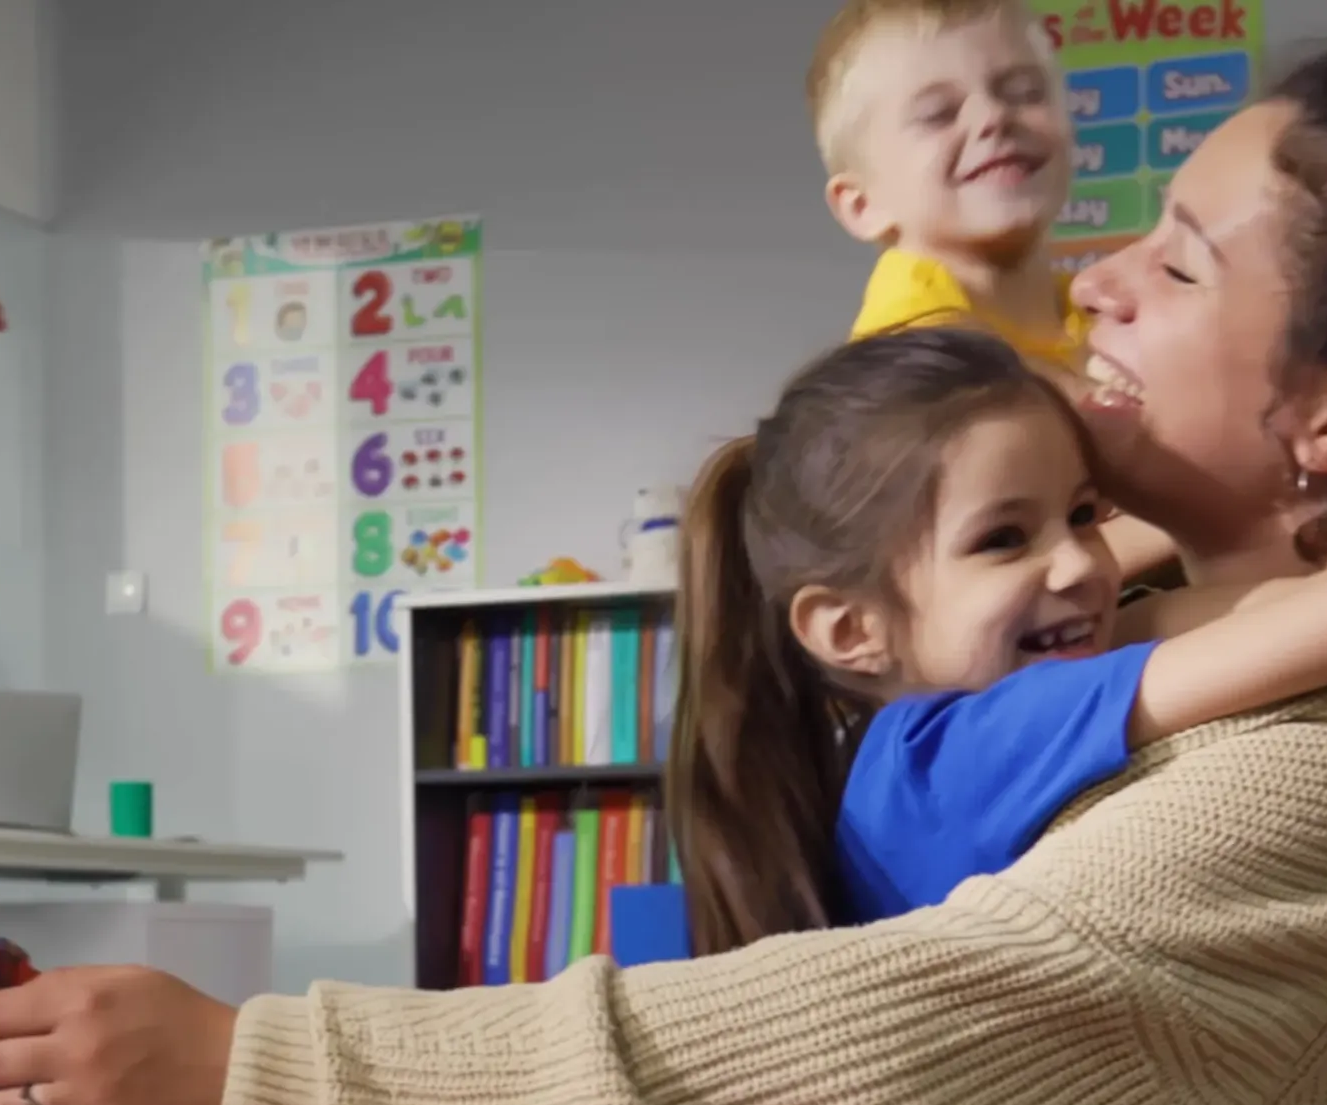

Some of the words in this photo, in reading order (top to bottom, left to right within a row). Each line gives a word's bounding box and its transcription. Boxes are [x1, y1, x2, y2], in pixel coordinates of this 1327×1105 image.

[1110, 0, 1247, 42] Week
[1160, 126, 1207, 156] Mo
[350, 271, 394, 336] 2
[222, 362, 260, 425] 3
[348, 350, 393, 415] 4
[352, 432, 393, 497] 6
[352, 510, 393, 577] 8
[221, 598, 262, 665] 9
